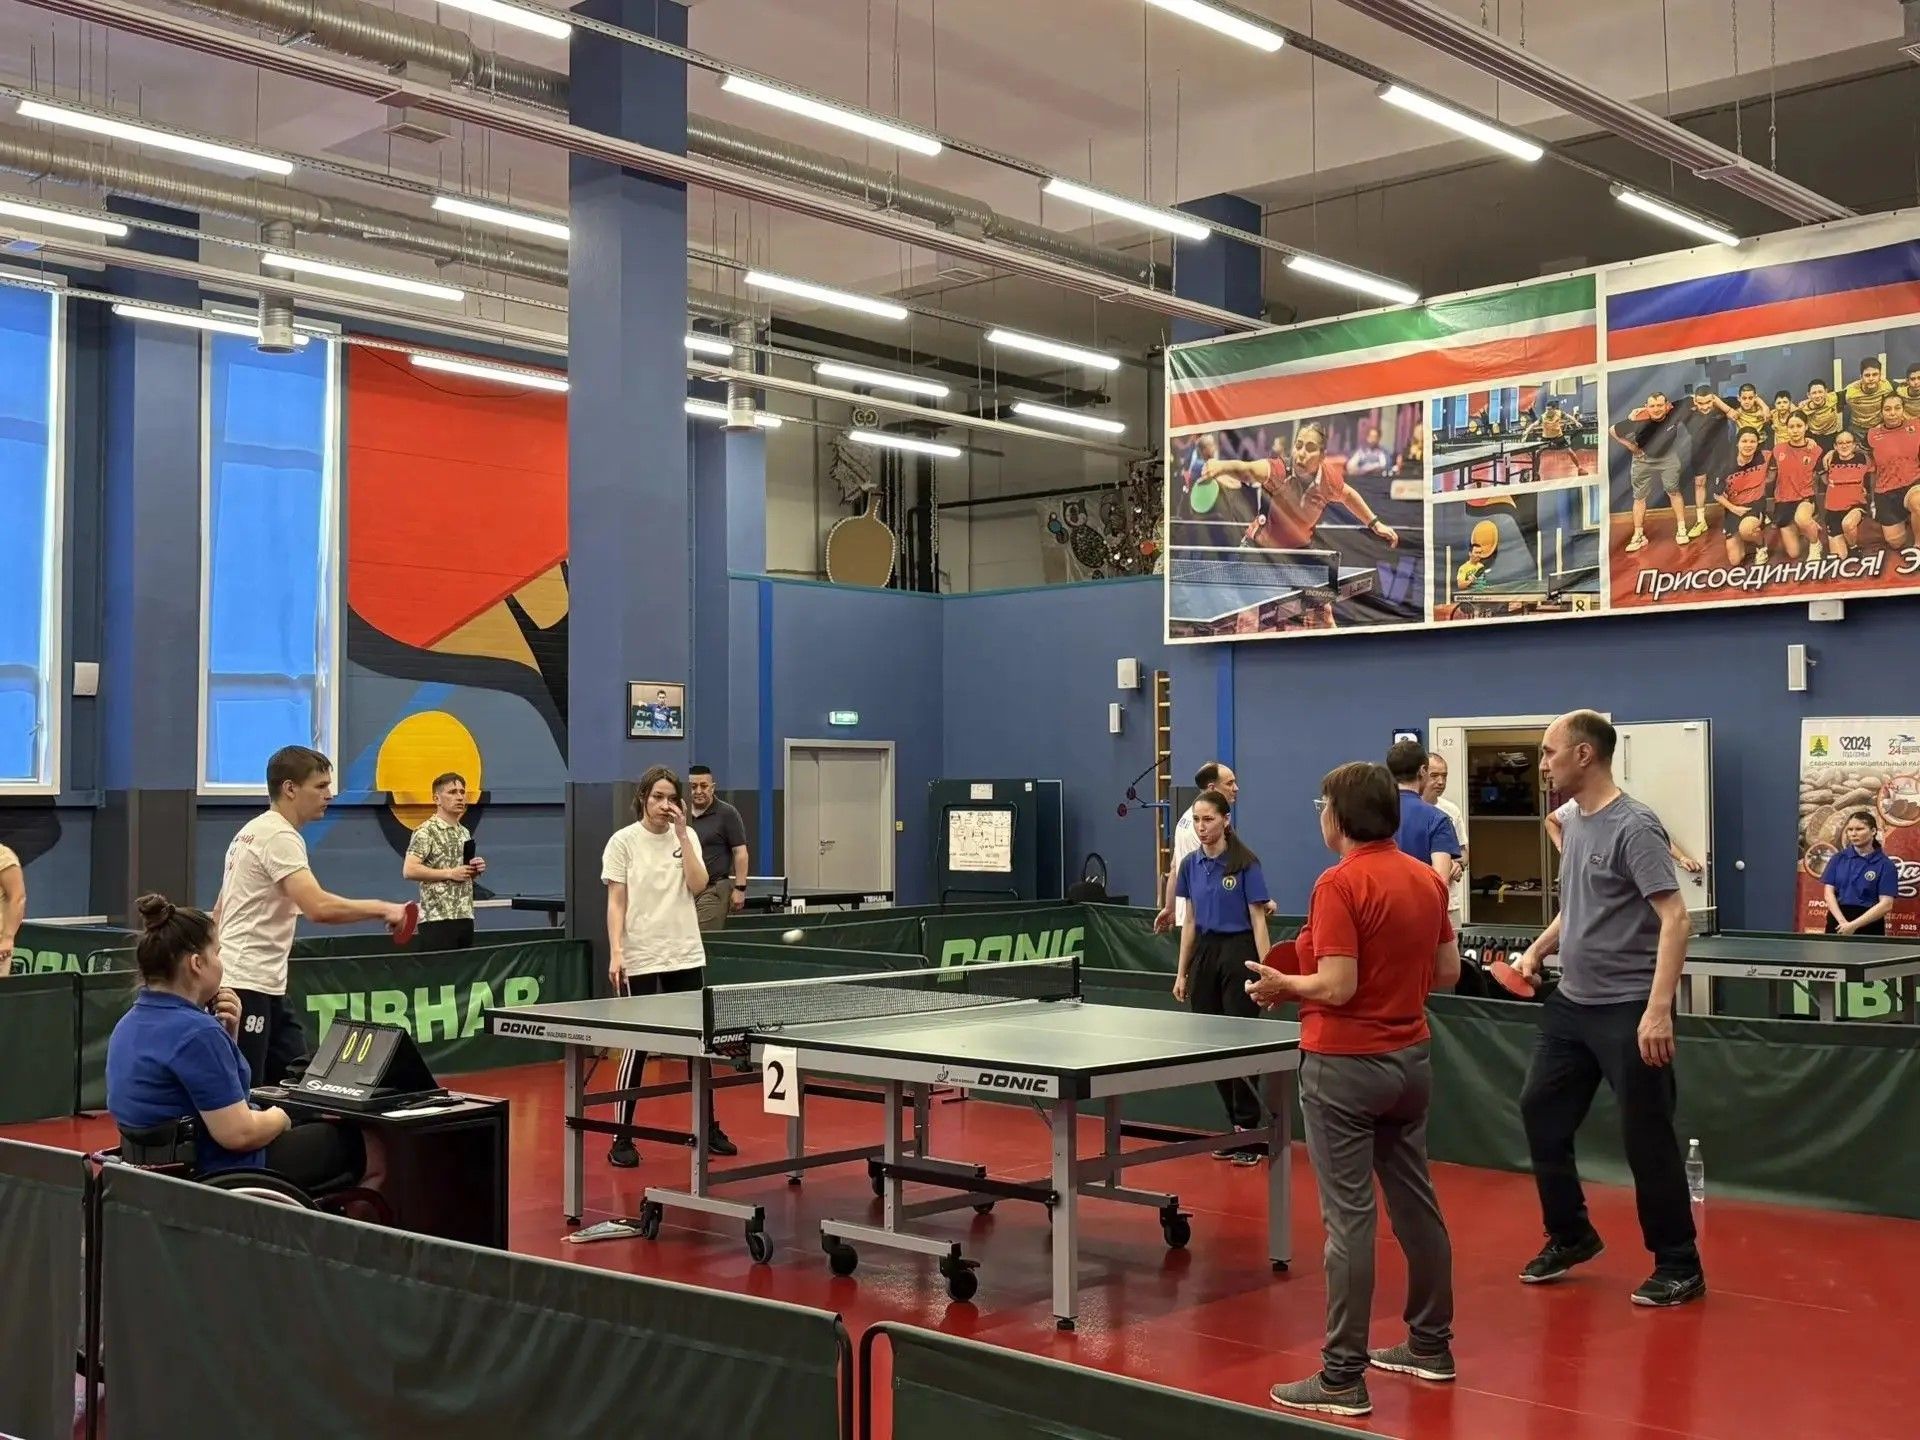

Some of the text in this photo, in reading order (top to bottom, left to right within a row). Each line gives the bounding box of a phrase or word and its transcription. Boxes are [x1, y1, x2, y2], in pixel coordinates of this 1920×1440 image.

[1635, 550, 1884, 600] Присоединяйся!
[1843, 736, 1871, 751] 2024
[1780, 968, 1838, 979] DONIC
[245, 1015, 265, 1034] 98
[500, 1021, 546, 1036] DONIC
[712, 1032, 746, 1045] DONIC
[767, 1060, 786, 1101] 2
[977, 1072, 1048, 1094] DONIC
[320, 1083, 365, 1097] DONIC
